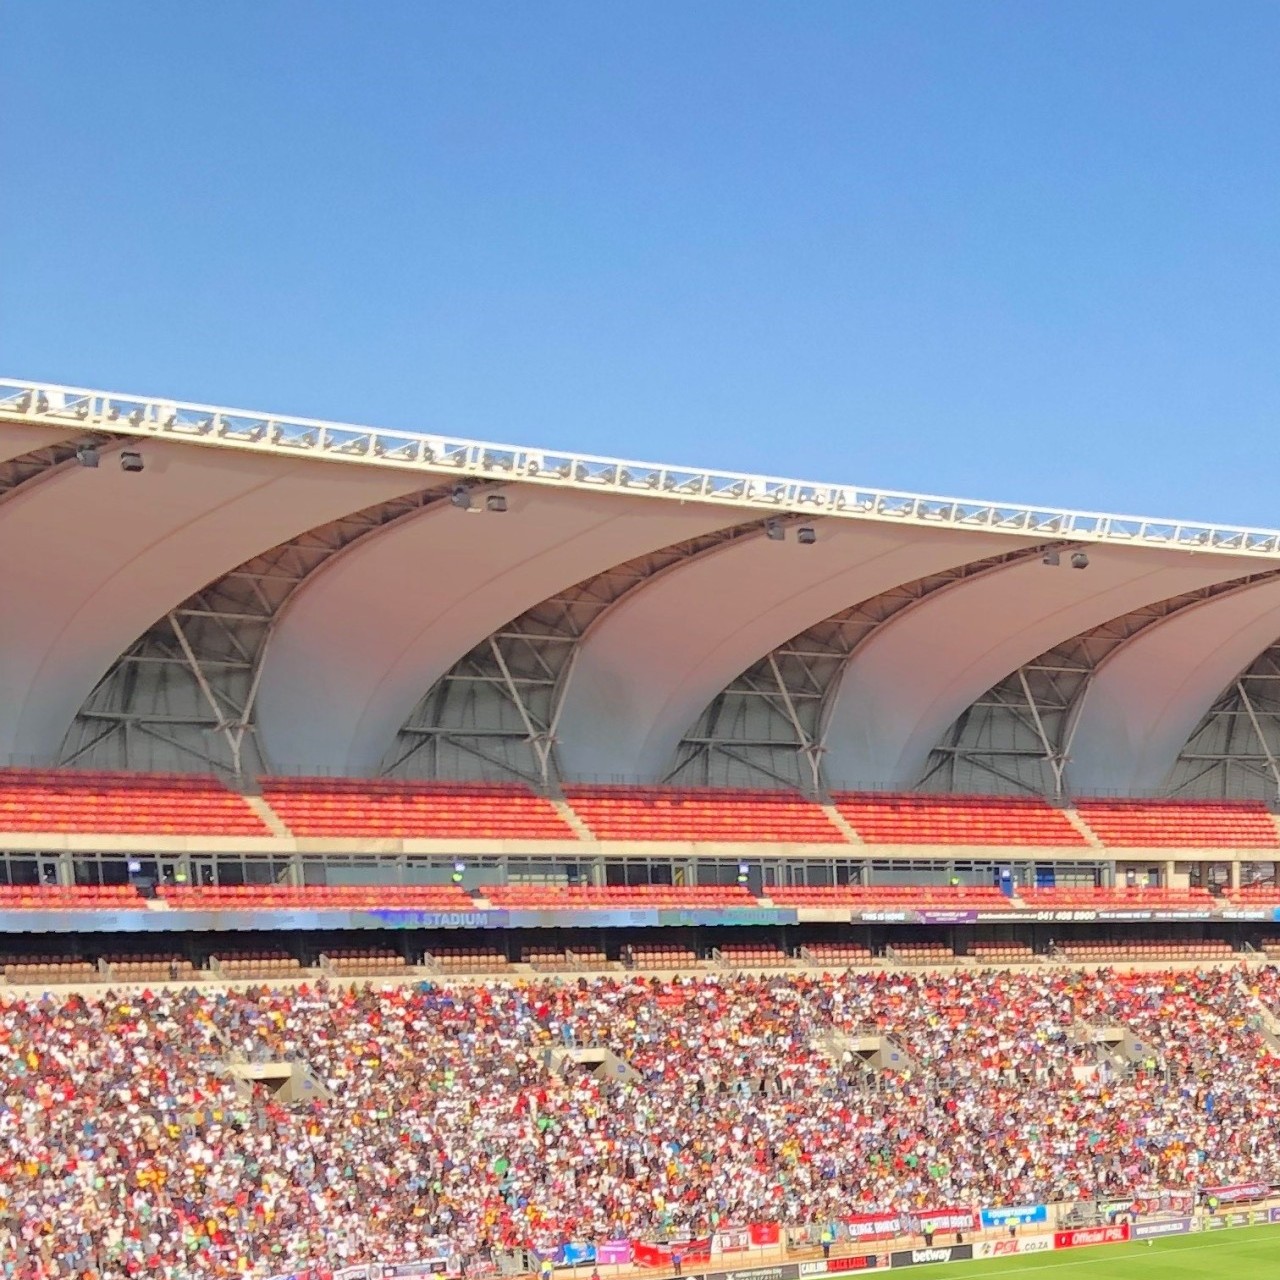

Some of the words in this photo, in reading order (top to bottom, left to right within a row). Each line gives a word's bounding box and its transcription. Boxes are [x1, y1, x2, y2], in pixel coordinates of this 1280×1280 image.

[423, 912, 488, 926] STADIUM
[1071, 1231, 1105, 1245] Official
[912, 1248, 952, 1263] betway
